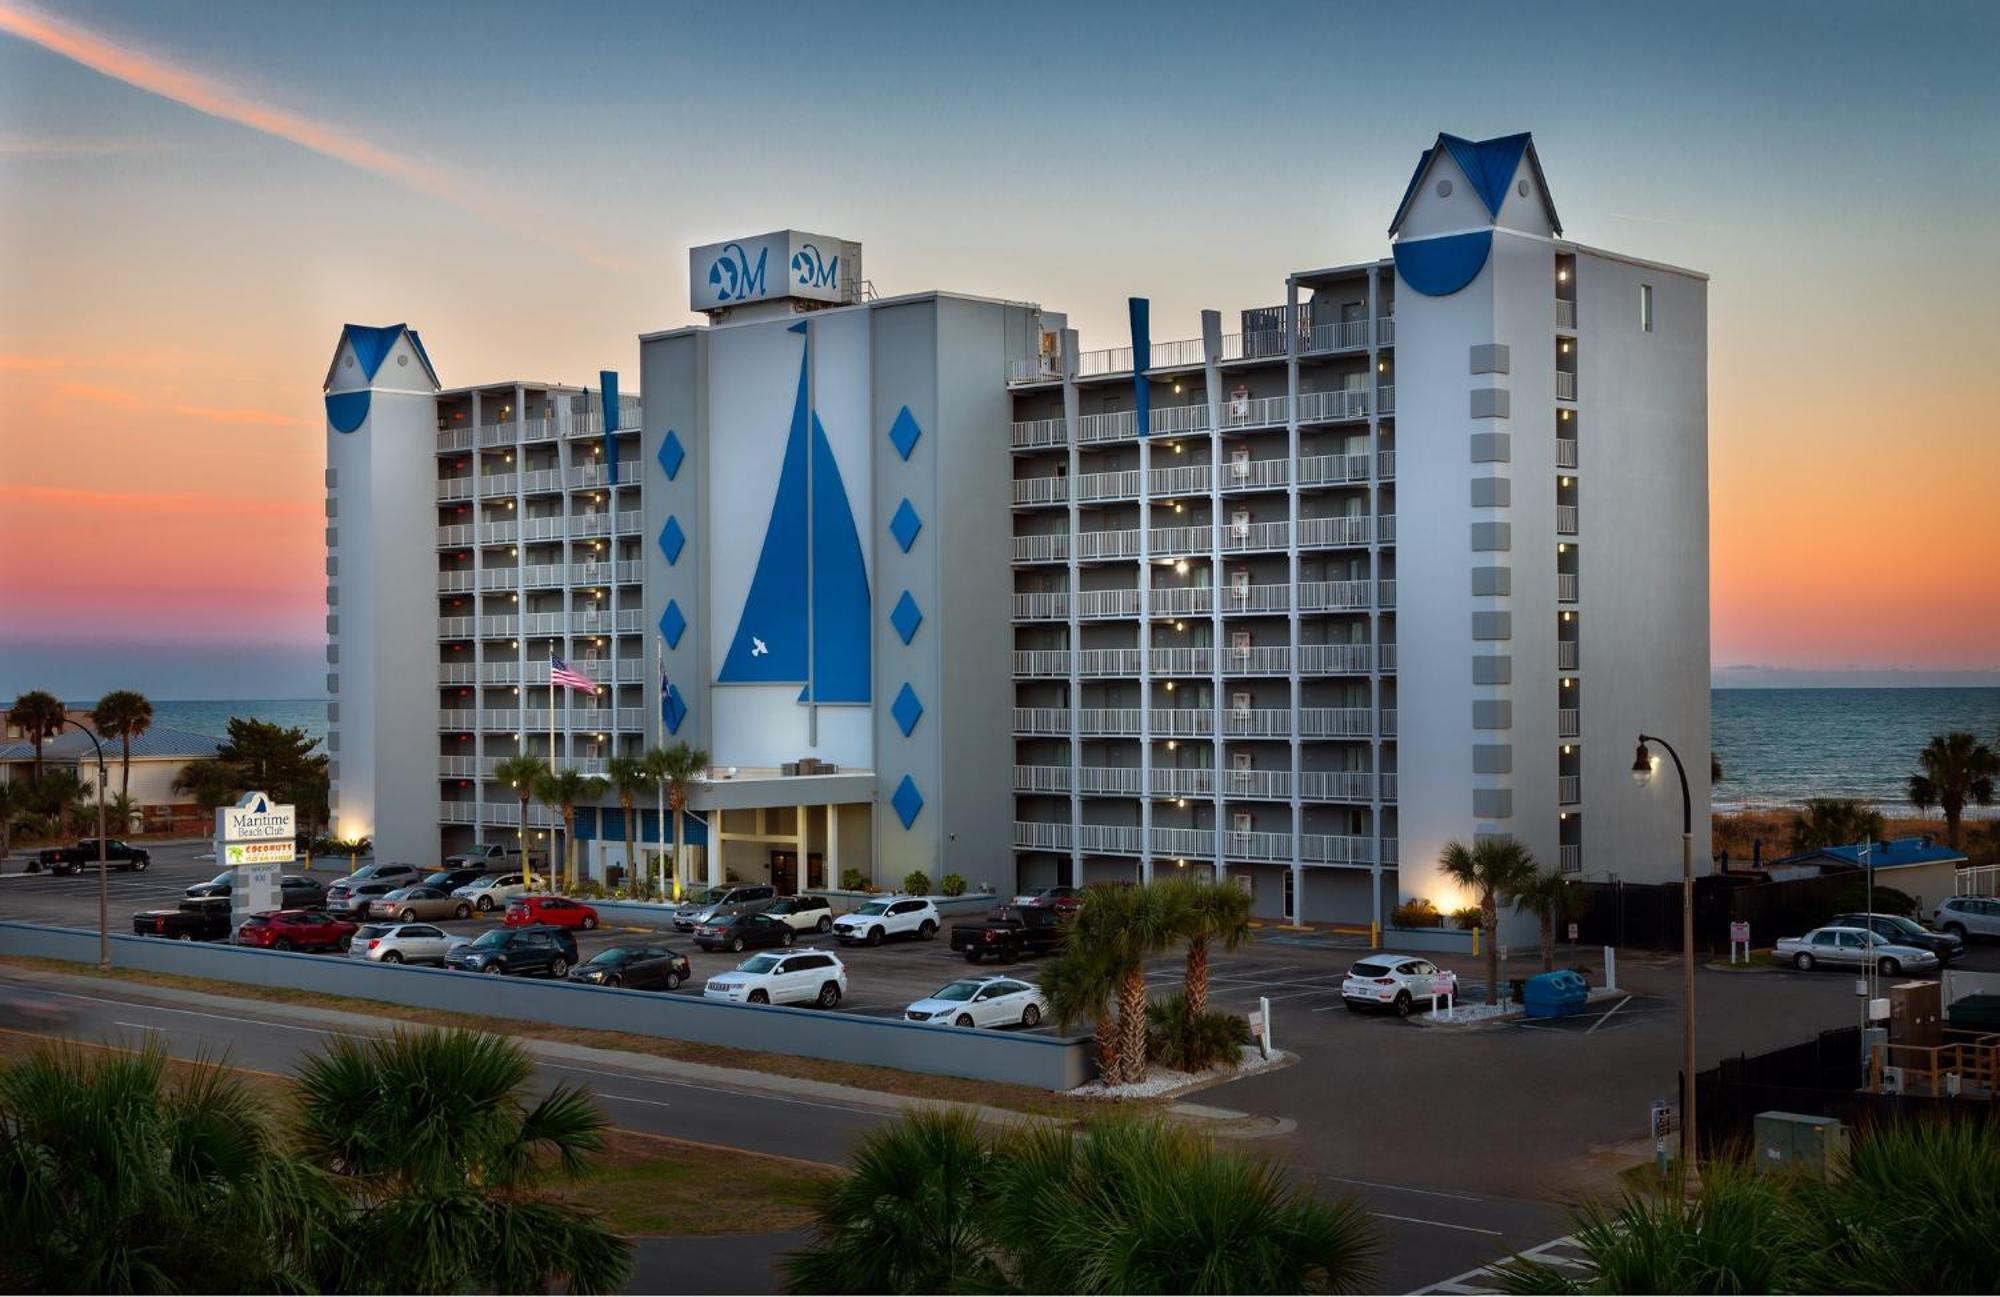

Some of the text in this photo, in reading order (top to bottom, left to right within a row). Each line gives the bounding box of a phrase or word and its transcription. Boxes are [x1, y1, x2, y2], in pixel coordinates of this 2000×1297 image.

[234, 813, 289, 828] Maritime
[239, 826, 285, 837] Beach Club
[246, 844, 292, 852] COCONUTS
